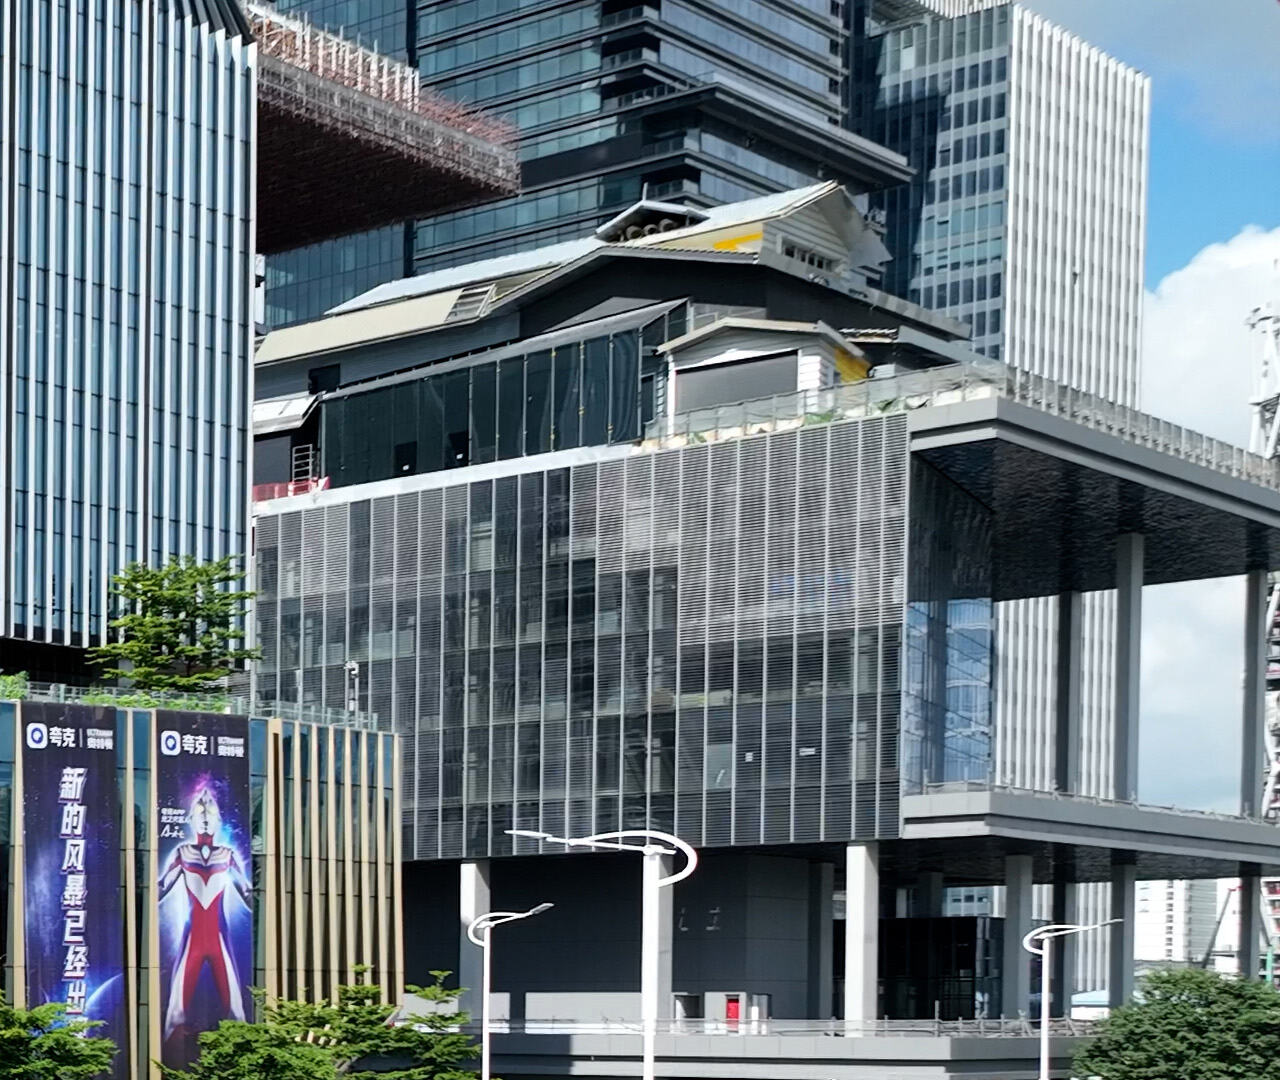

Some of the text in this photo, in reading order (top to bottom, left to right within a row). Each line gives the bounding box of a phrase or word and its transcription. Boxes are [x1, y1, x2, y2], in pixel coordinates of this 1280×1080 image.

[48, 726, 77, 748] 夸克
[182, 734, 208, 755] 夸克
[58, 766, 88, 1040] 新的风暴已经出
